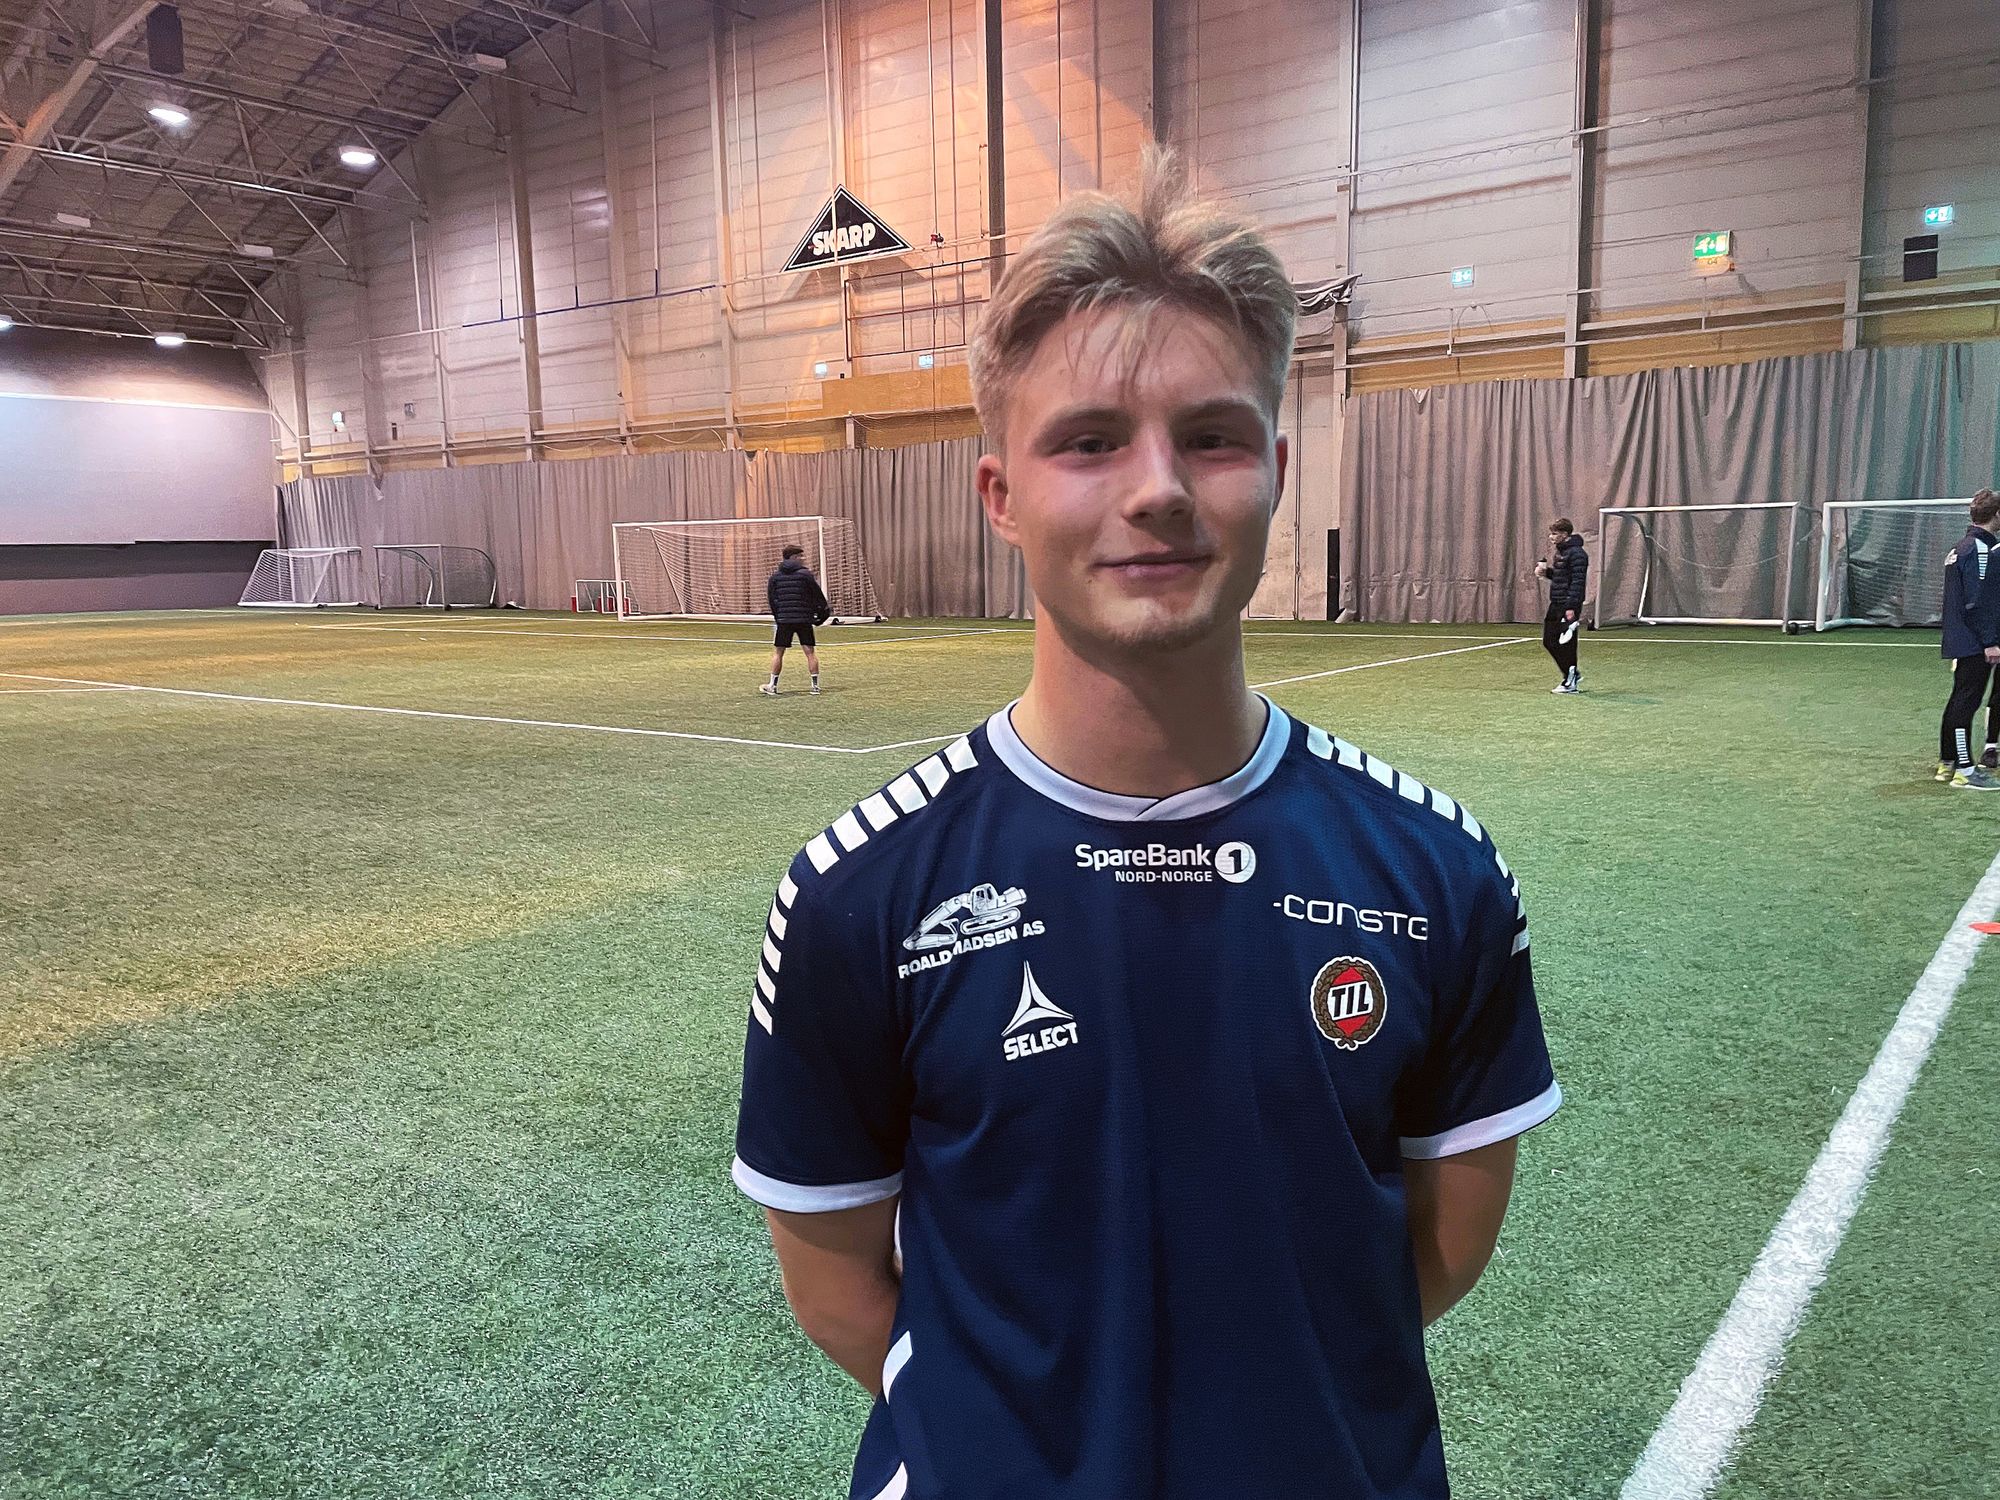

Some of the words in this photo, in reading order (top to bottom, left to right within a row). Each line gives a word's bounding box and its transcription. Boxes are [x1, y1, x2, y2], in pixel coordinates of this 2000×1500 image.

[812, 222, 876, 256] SKARP
[1074, 843, 1212, 871] SpareBank
[1114, 870, 1213, 883] NORD-NORGE
[897, 949, 953, 979] ROALD
[1022, 920, 1046, 938] AS
[1330, 983, 1370, 1018] TIL
[1003, 1022, 1079, 1061] SELECT
